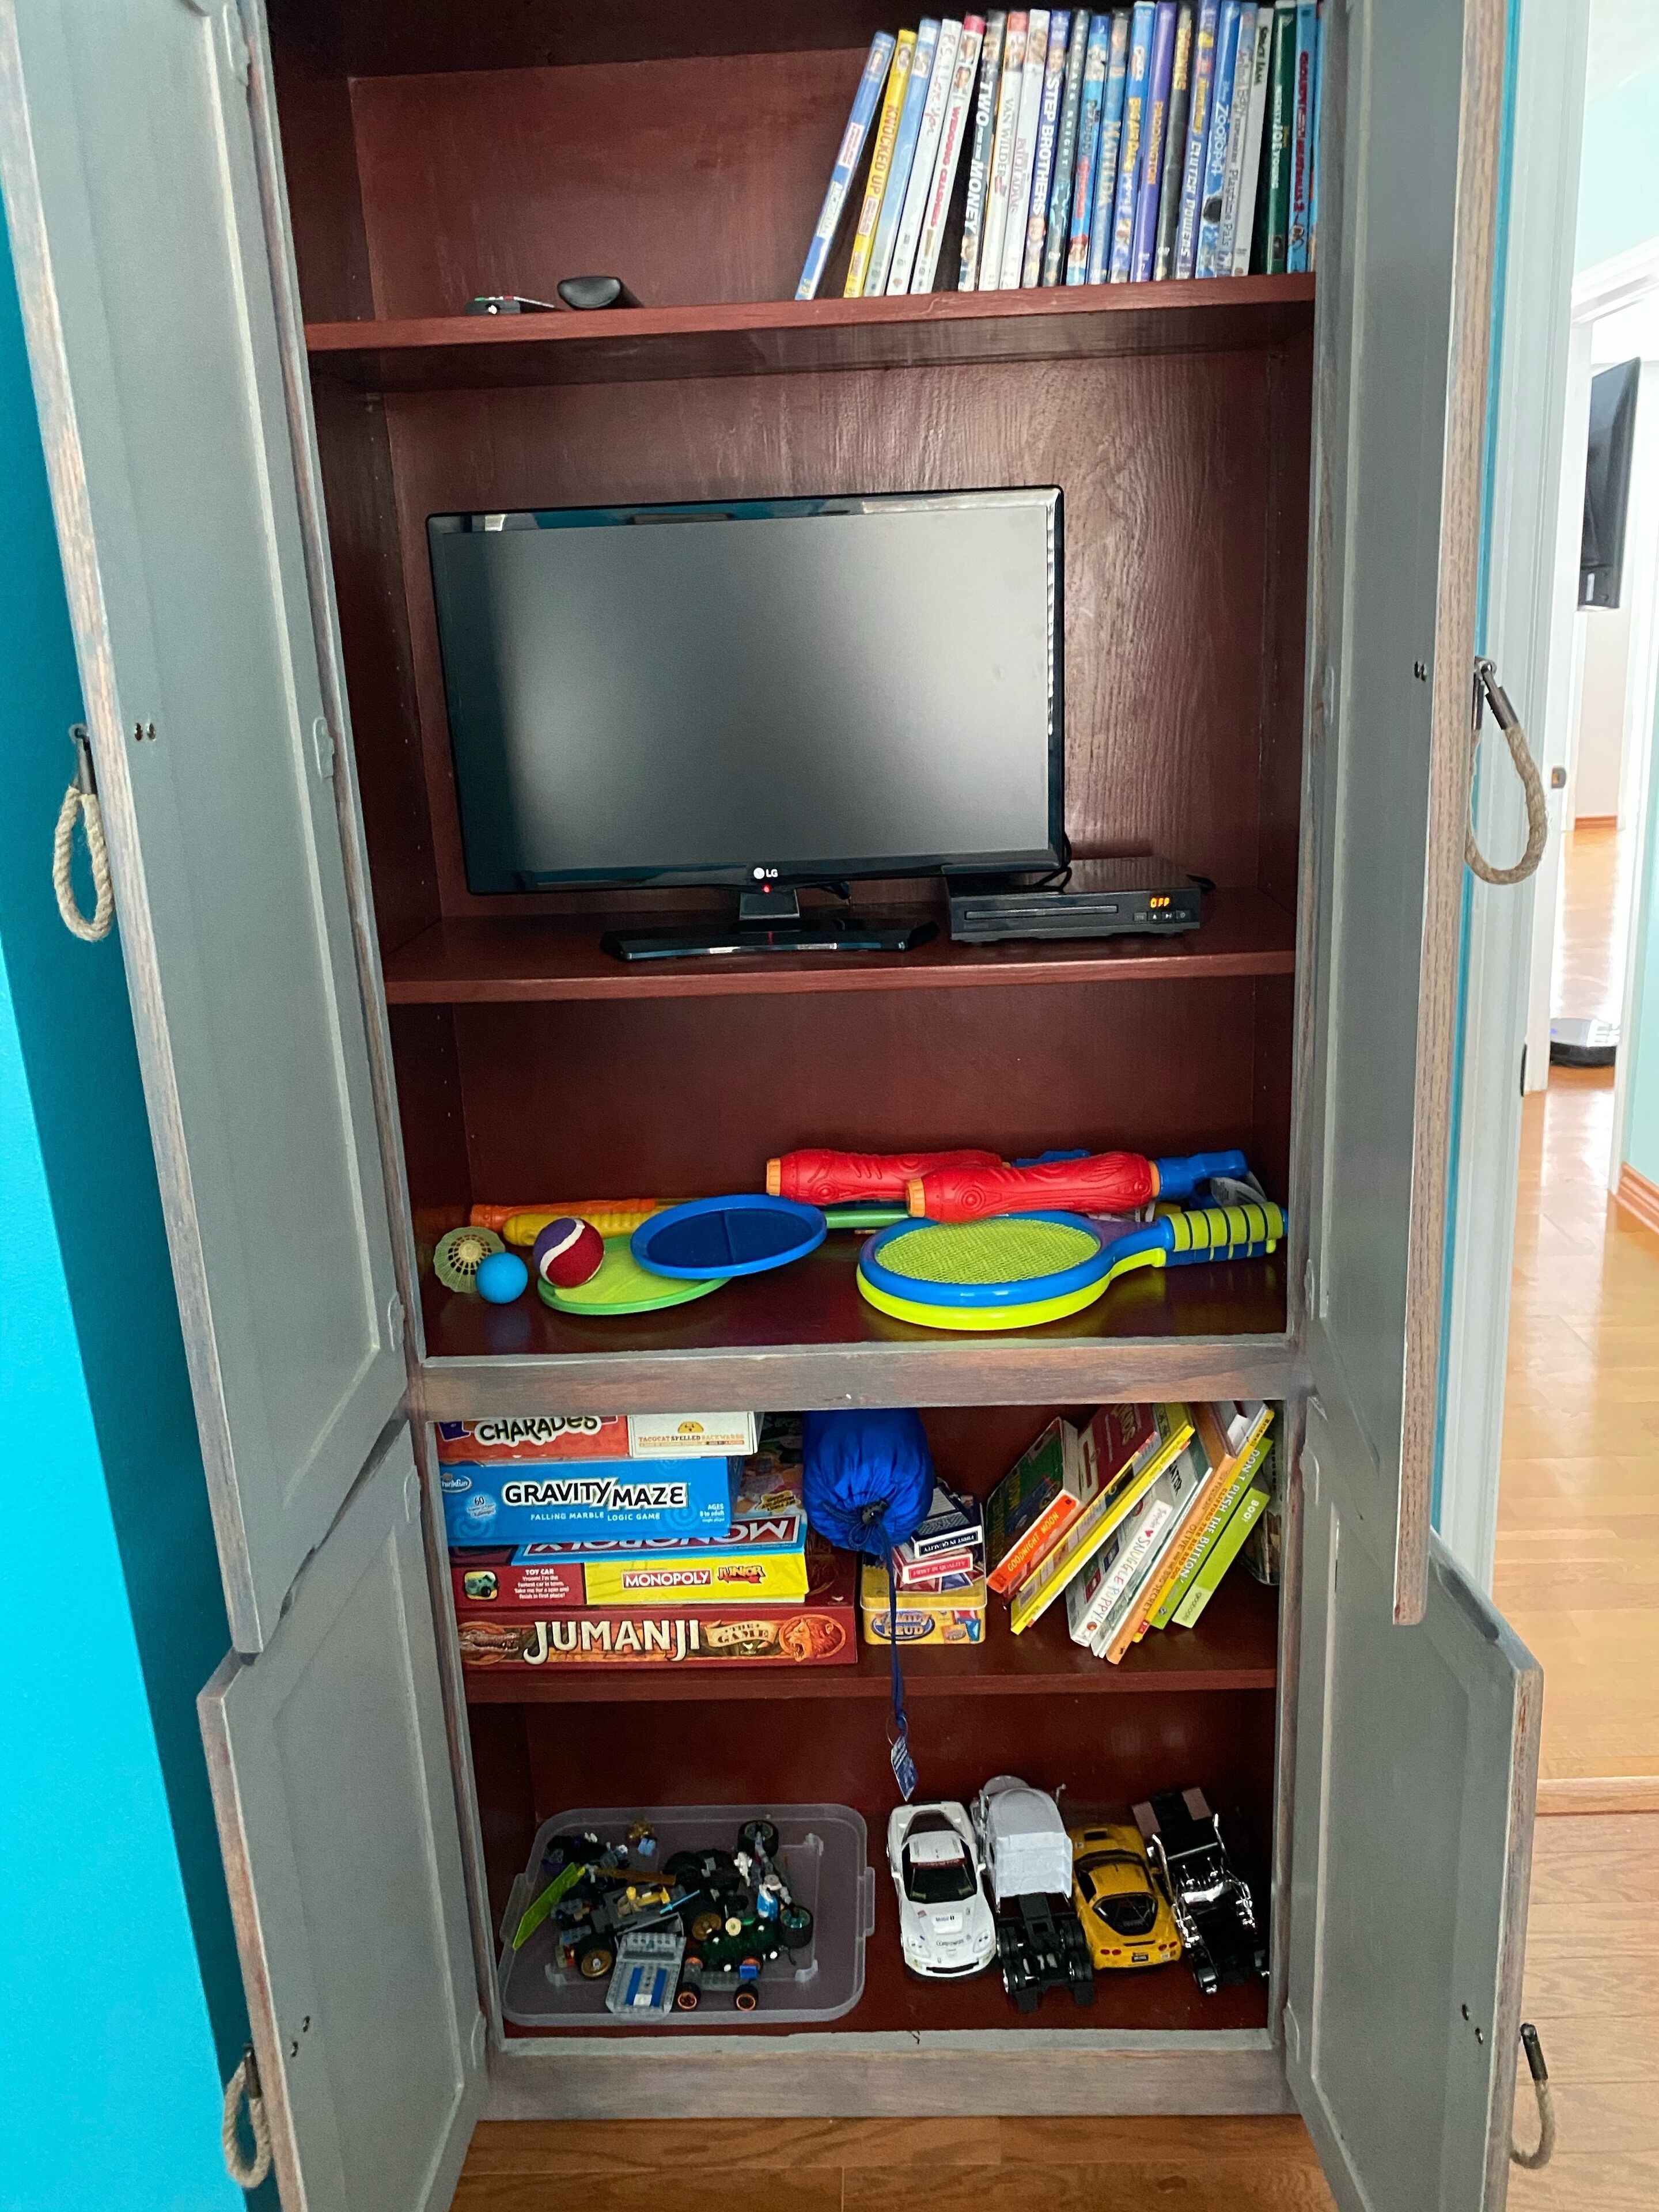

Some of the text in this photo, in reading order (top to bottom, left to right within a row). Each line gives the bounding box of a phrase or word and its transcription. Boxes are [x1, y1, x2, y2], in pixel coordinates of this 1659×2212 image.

[1254, 26, 1268, 85] SPACE JAM
[1069, 62, 1081, 100] DARK
[976, 81, 993, 126] TWO
[870, 106, 899, 195] KNOCKED UP
[995, 97, 1014, 176] VAN WILDER
[1032, 77, 1059, 215] STEP BROTHERS
[1062, 110, 1074, 165] KNIGHT
[1147, 101, 1164, 184] PADDINGTON
[1211, 101, 1229, 176] ZOOTOPIA
[1271, 124, 1283, 152] JOE
[930, 106, 961, 228] WEDDING CRASHERS
[1099, 120, 1121, 206] MATILDA
[964, 159, 984, 234] MONEY
[1181, 141, 1201, 257] CLUTCH POWERS
[1225, 169, 1239, 221] Playtime
[1222, 223, 1233, 247] Pals
[766, 869, 778, 877] LG
[479, 1416, 598, 1442] CHARADES
[1250, 1419, 1270, 1446] Bridwell
[1238, 1449, 1260, 1482] DON'T
[474, 1497, 484, 1506] 60
[505, 1481, 684, 1506] GRAVITY MAZE
[1220, 1484, 1240, 1512] PUSH
[1242, 1499, 1260, 1522] BOO!
[569, 1512, 604, 1520] MARBLE
[1169, 1486, 1227, 1581] CLIFFORD THE BIG RED DOG
[1206, 1516, 1222, 1534] THE
[1007, 1532, 1040, 1571] GOODNIGHT
[1040, 1512, 1059, 1535] MOON
[1180, 1524, 1197, 1551] OLIVE
[625, 1566, 765, 1587] MONOPOLY JUNIOR
[913, 1567, 930, 1576] FIRST
[940, 1561, 965, 1571] QUALITY
[1114, 1536, 1151, 1585] SNUGGLE
[1093, 1586, 1120, 1624] PUPPY!
[1141, 1583, 1162, 1613] SECRET
[524, 1620, 700, 1665] JUMANJI
[718, 1627, 770, 1644] GAME
[730, 1623, 755, 1632] THE
